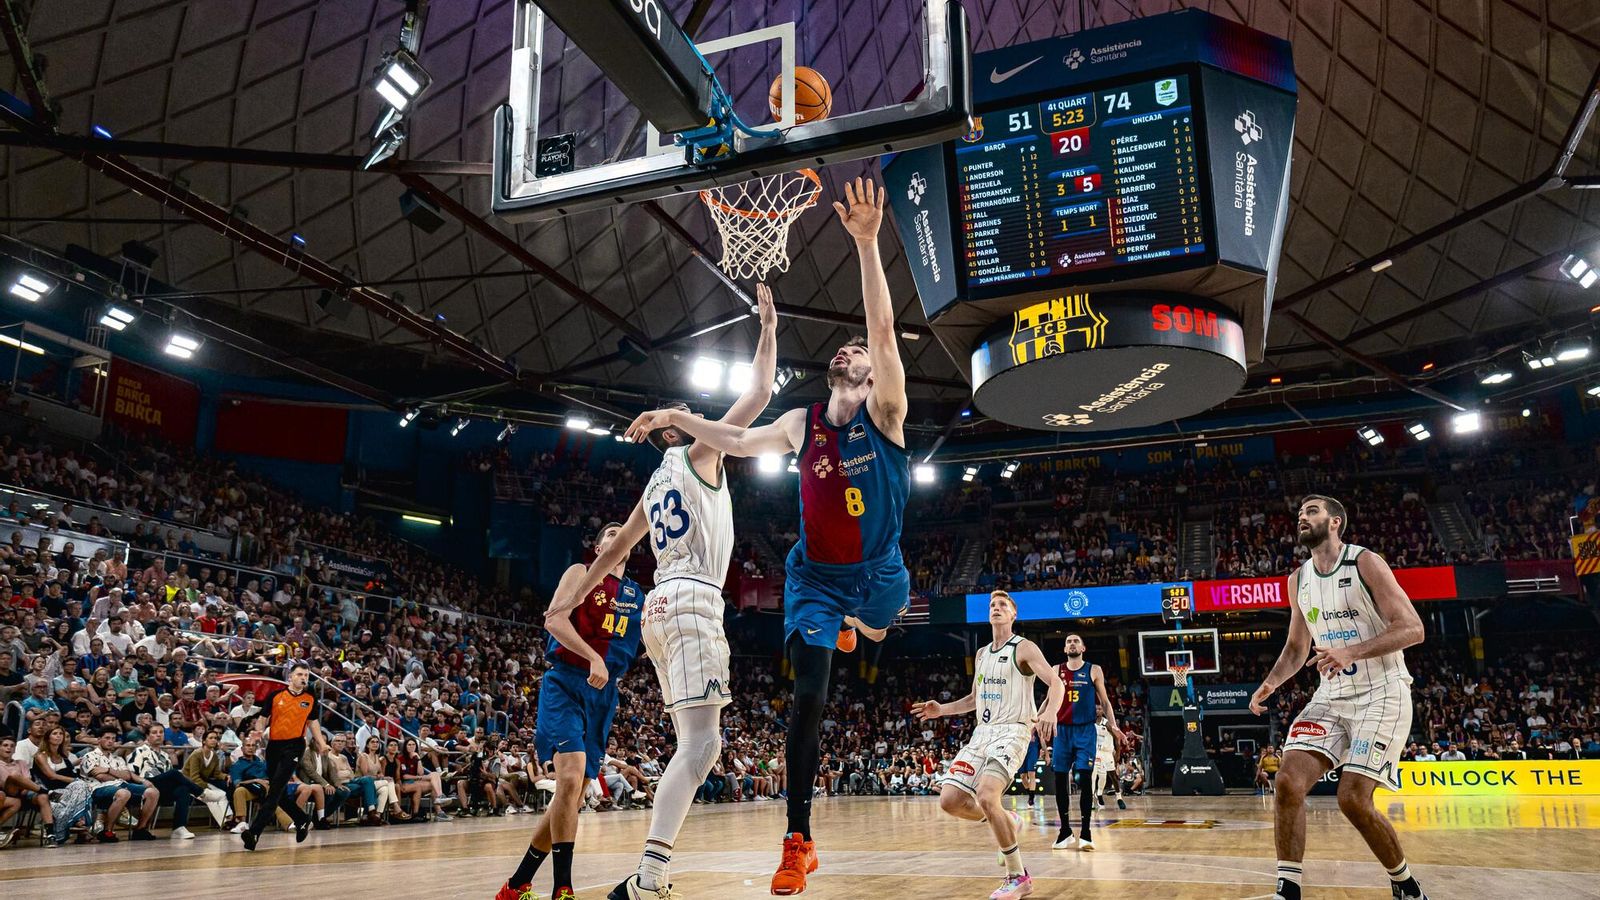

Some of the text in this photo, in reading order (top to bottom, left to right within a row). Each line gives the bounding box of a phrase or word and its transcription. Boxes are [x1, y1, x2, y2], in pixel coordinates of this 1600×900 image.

[1090, 40, 1142, 55] Assistència
[1058, 97, 1087, 110] QUART
[1103, 92, 1131, 114] 74
[1009, 111, 1032, 132] 51
[1053, 109, 1084, 127] 5:23
[1132, 114, 1162, 124] UNICAJA
[1059, 135, 1082, 154] 20
[1117, 135, 1138, 145] PÉREZ
[984, 143, 1006, 153] BARÇA
[1117, 140, 1166, 154] BALCEROWSKI
[1118, 156, 1135, 164] EJIM
[969, 162, 993, 172] PUNTER
[1119, 162, 1156, 174] KALINOSKI
[969, 169, 1004, 181] ANDERSON
[1062, 169, 1085, 178] FALTES
[1120, 175, 1145, 184] TAYLOR
[970, 180, 1001, 190] BRIZUELA
[1234, 151, 1246, 209] Sanitària
[1057, 177, 1093, 196] 3 5
[1121, 183, 1156, 194] BARREIRO
[971, 187, 1012, 200] SATORANSKY
[1245, 154, 1258, 236] Assistència
[972, 196, 1020, 209] HERNANGÓMEZ
[1122, 196, 1138, 204] DÍAZ
[1056, 204, 1097, 216] TEMPS MORT
[1123, 204, 1149, 214] CARTER
[974, 219, 1001, 229] ABRINES
[1061, 215, 1096, 232] 1 1
[1124, 213, 1157, 224] DJEDOVIC
[975, 229, 999, 238] PARKER
[1125, 225, 1145, 233] TILLIE
[975, 239, 994, 247] KEITA
[1126, 233, 1156, 243] KRAVISH
[921, 210, 941, 283] Assistència
[976, 248, 998, 257] PARRA
[1127, 244, 1149, 253] PERRY
[977, 258, 1000, 266] VILLAR
[978, 266, 1011, 276] GONZÁLEZ
[1079, 363, 1170, 411] Assistència
[845, 487, 865, 516] 8
[651, 489, 689, 550] 33
[1172, 599, 1189, 609] 20
[1322, 608, 1359, 621] Unicaja
[602, 614, 628, 637] 44
[1068, 690, 1079, 702] 13
[1169, 689, 1184, 707] A
[982, 709, 990, 723] 9
[1412, 769, 1583, 786] UNLOCK THE
